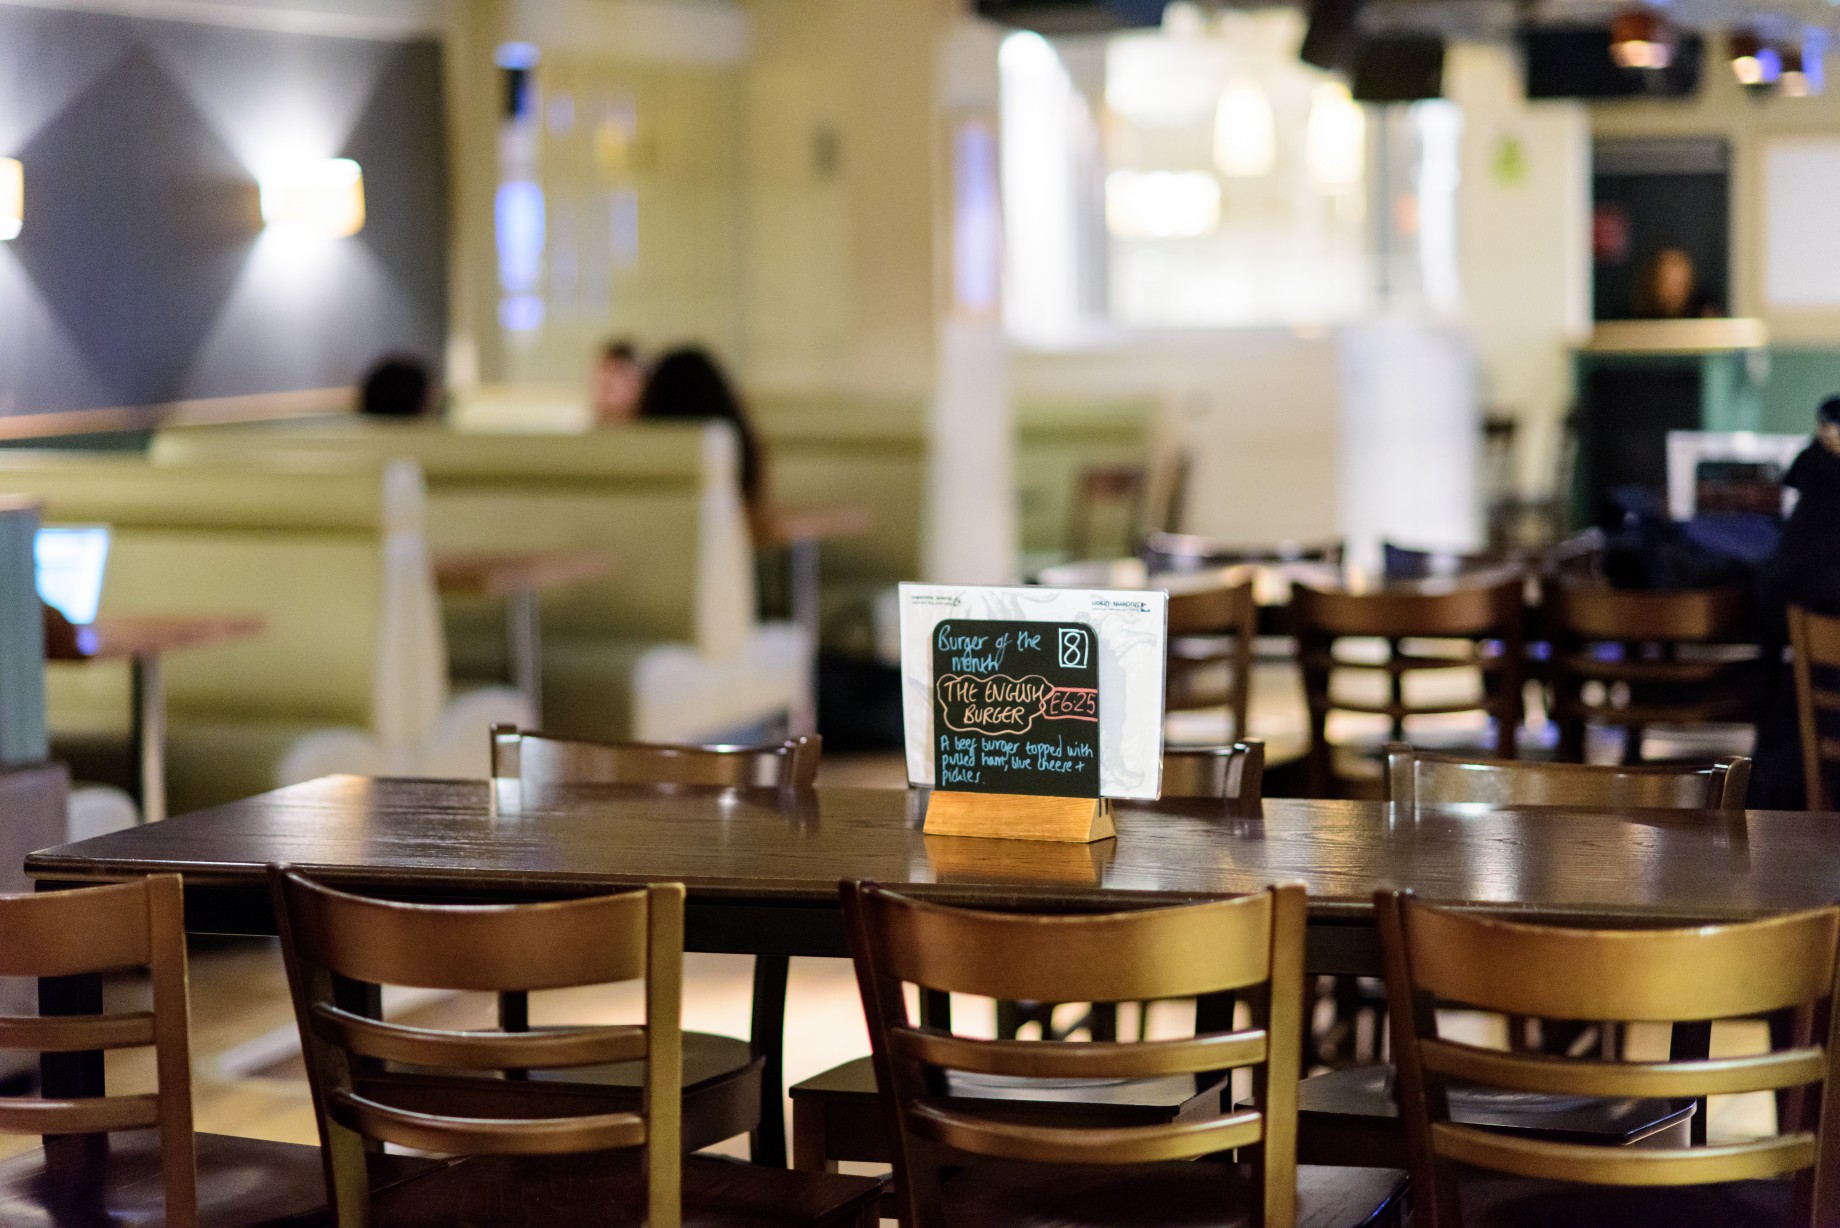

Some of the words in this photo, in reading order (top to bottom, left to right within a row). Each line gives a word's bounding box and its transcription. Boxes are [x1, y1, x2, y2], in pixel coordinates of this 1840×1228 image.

[938, 625, 988, 661] Burger
[996, 633, 1013, 665] of
[1017, 631, 1041, 651] the
[1064, 632, 1081, 665] 8
[952, 654, 999, 673] month
[944, 680, 978, 703] THE
[964, 704, 1024, 725] BURGER
[941, 735, 950, 751] A
[955, 736, 977, 757] beef
[982, 738, 1020, 759] burger
[1026, 735, 1062, 759] topped
[1067, 742, 1093, 757] with
[942, 753, 975, 769] pulled
[1011, 756, 1031, 769] blue
[1038, 758, 1072, 772] cheese
